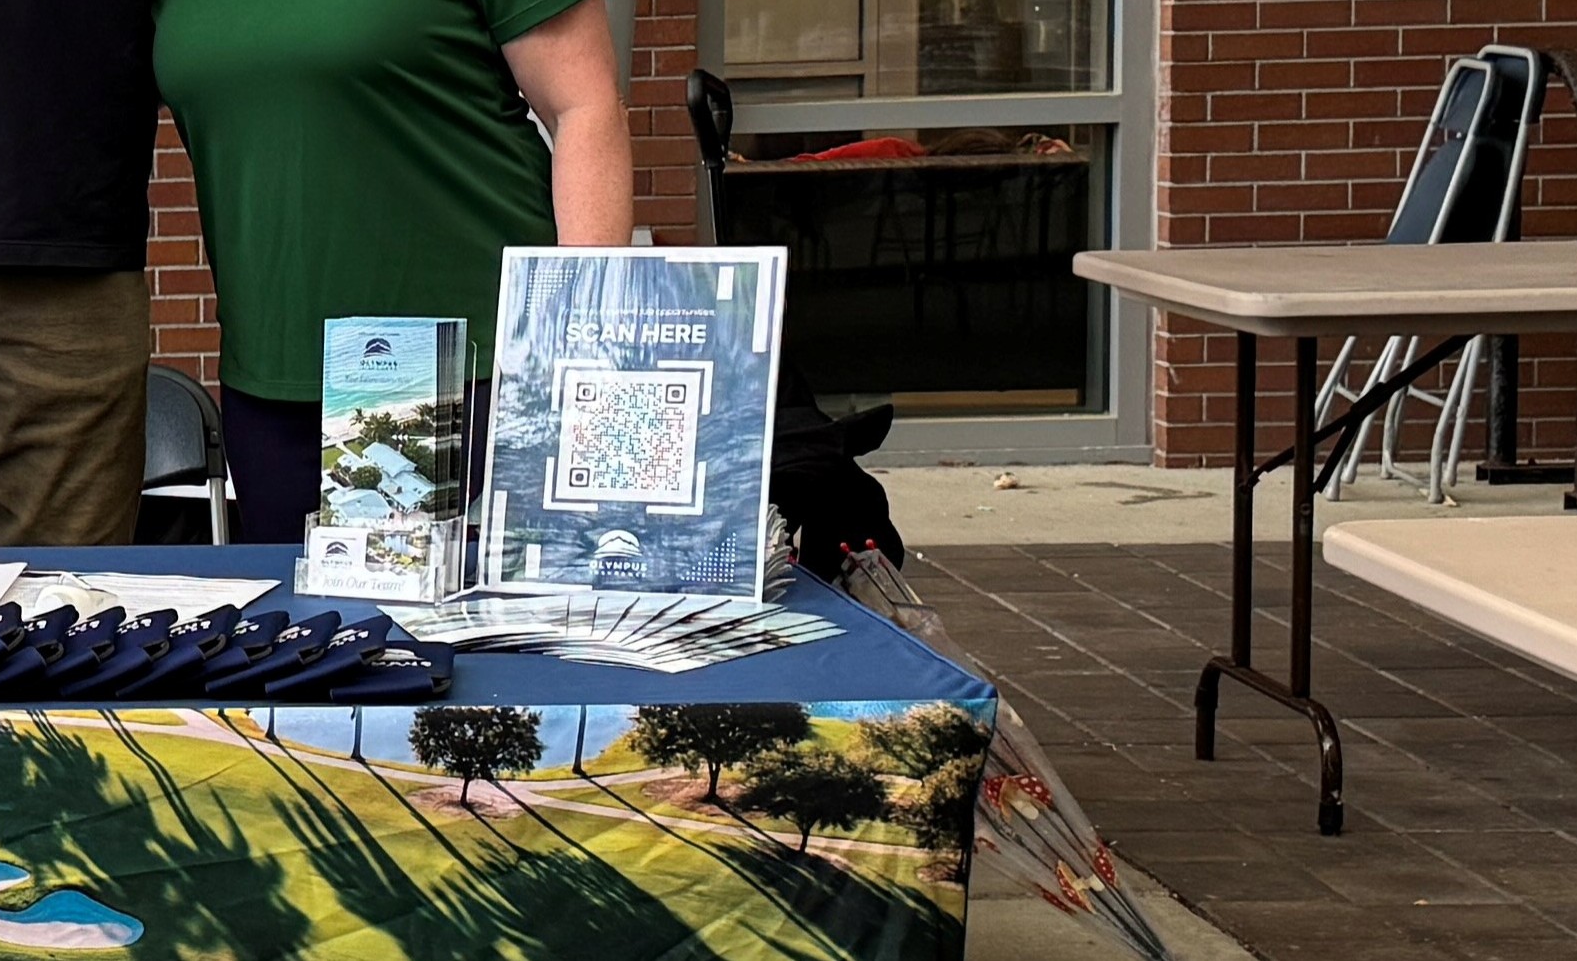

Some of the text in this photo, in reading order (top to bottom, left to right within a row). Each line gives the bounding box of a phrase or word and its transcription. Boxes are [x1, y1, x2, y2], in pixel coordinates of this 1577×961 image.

[565, 323, 707, 344] SCAN HERE
[589, 560, 648, 571] OLYMPUS
